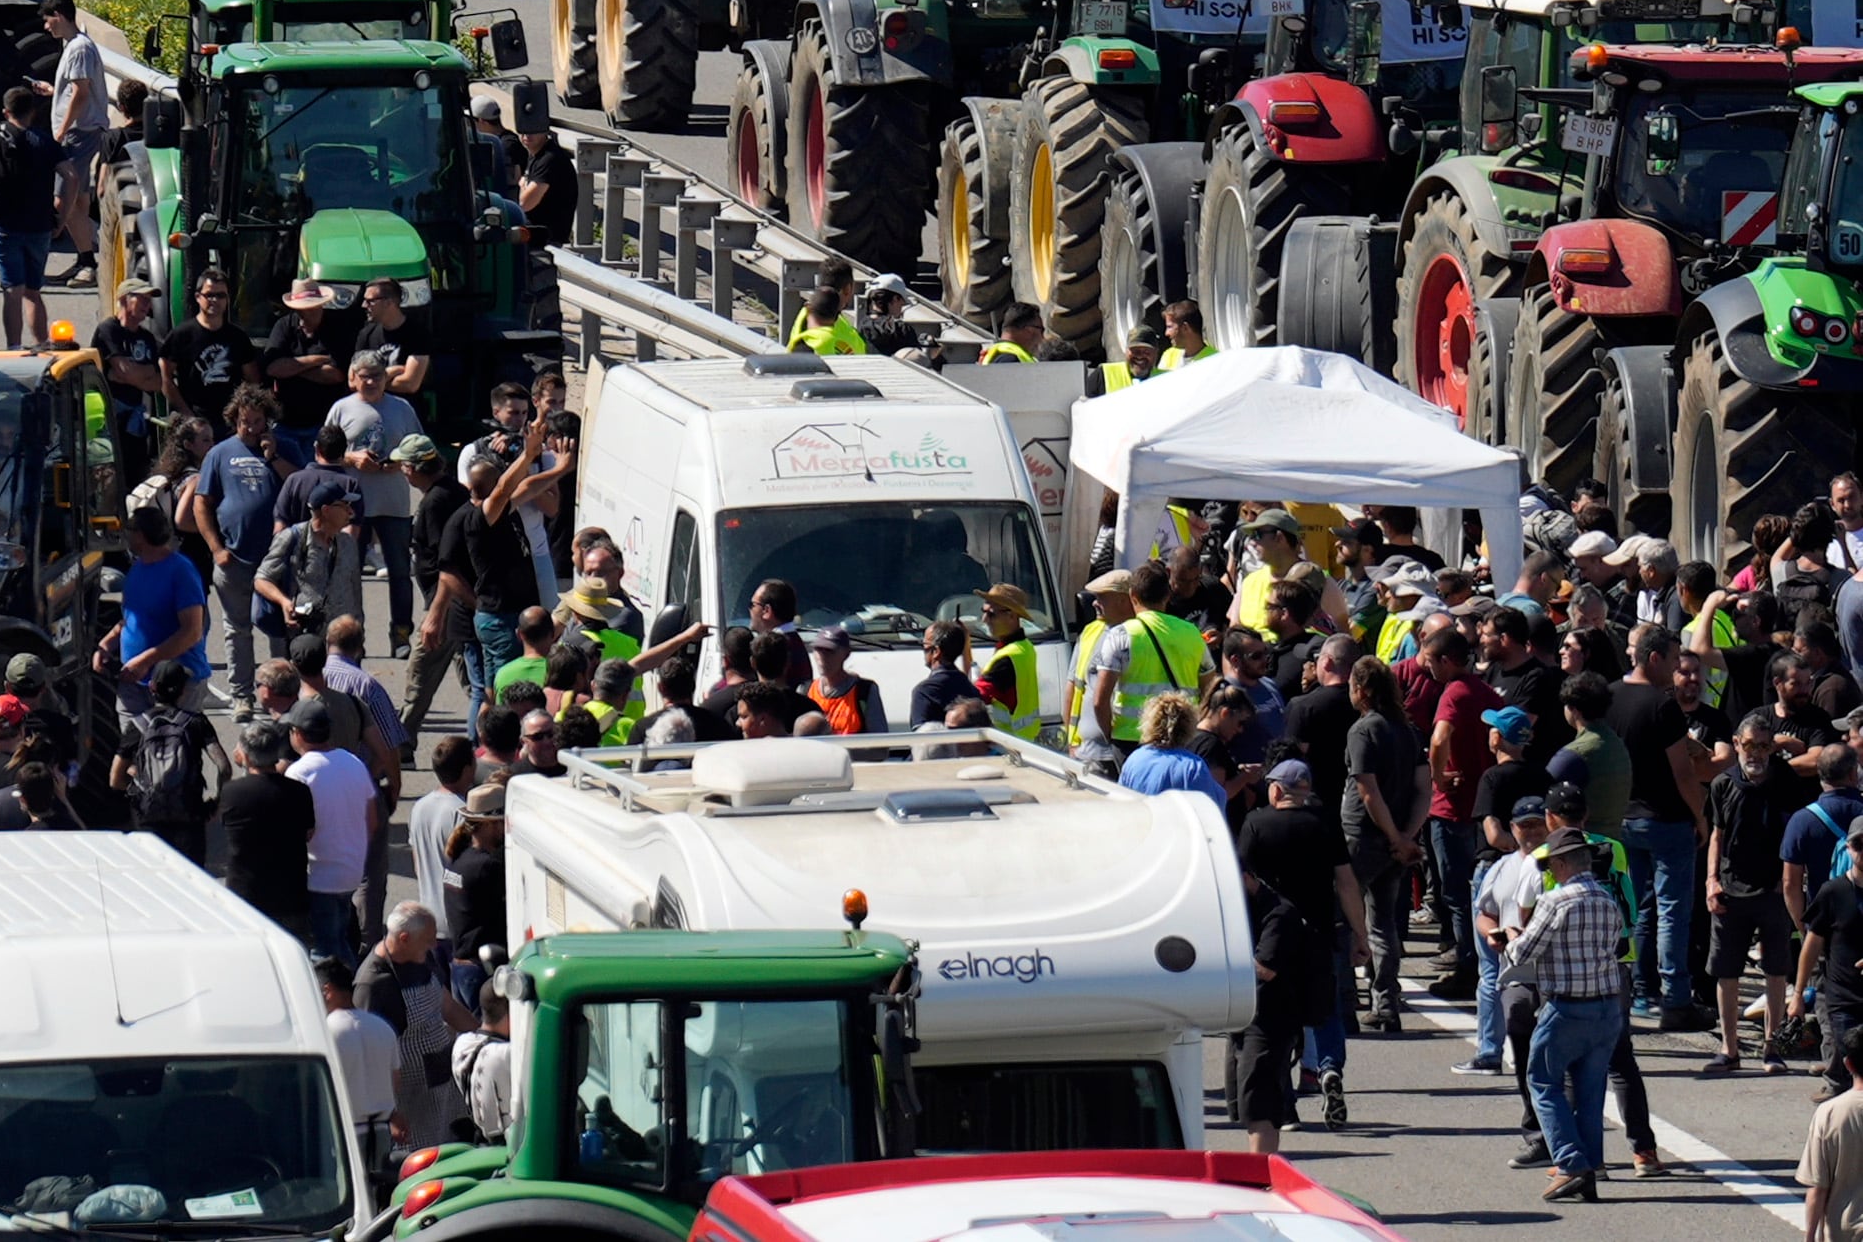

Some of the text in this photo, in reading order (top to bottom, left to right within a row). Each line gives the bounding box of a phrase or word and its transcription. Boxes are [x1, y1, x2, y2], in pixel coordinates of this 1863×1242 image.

[1086, 4, 1123, 16] E 7715
[1185, 0, 1253, 19] HI SOM
[1413, 27, 1471, 44] HI SO
[1571, 119, 1612, 136] E 1905
[1839, 233, 1861, 256] 50
[947, 948, 1054, 983] elnagh
